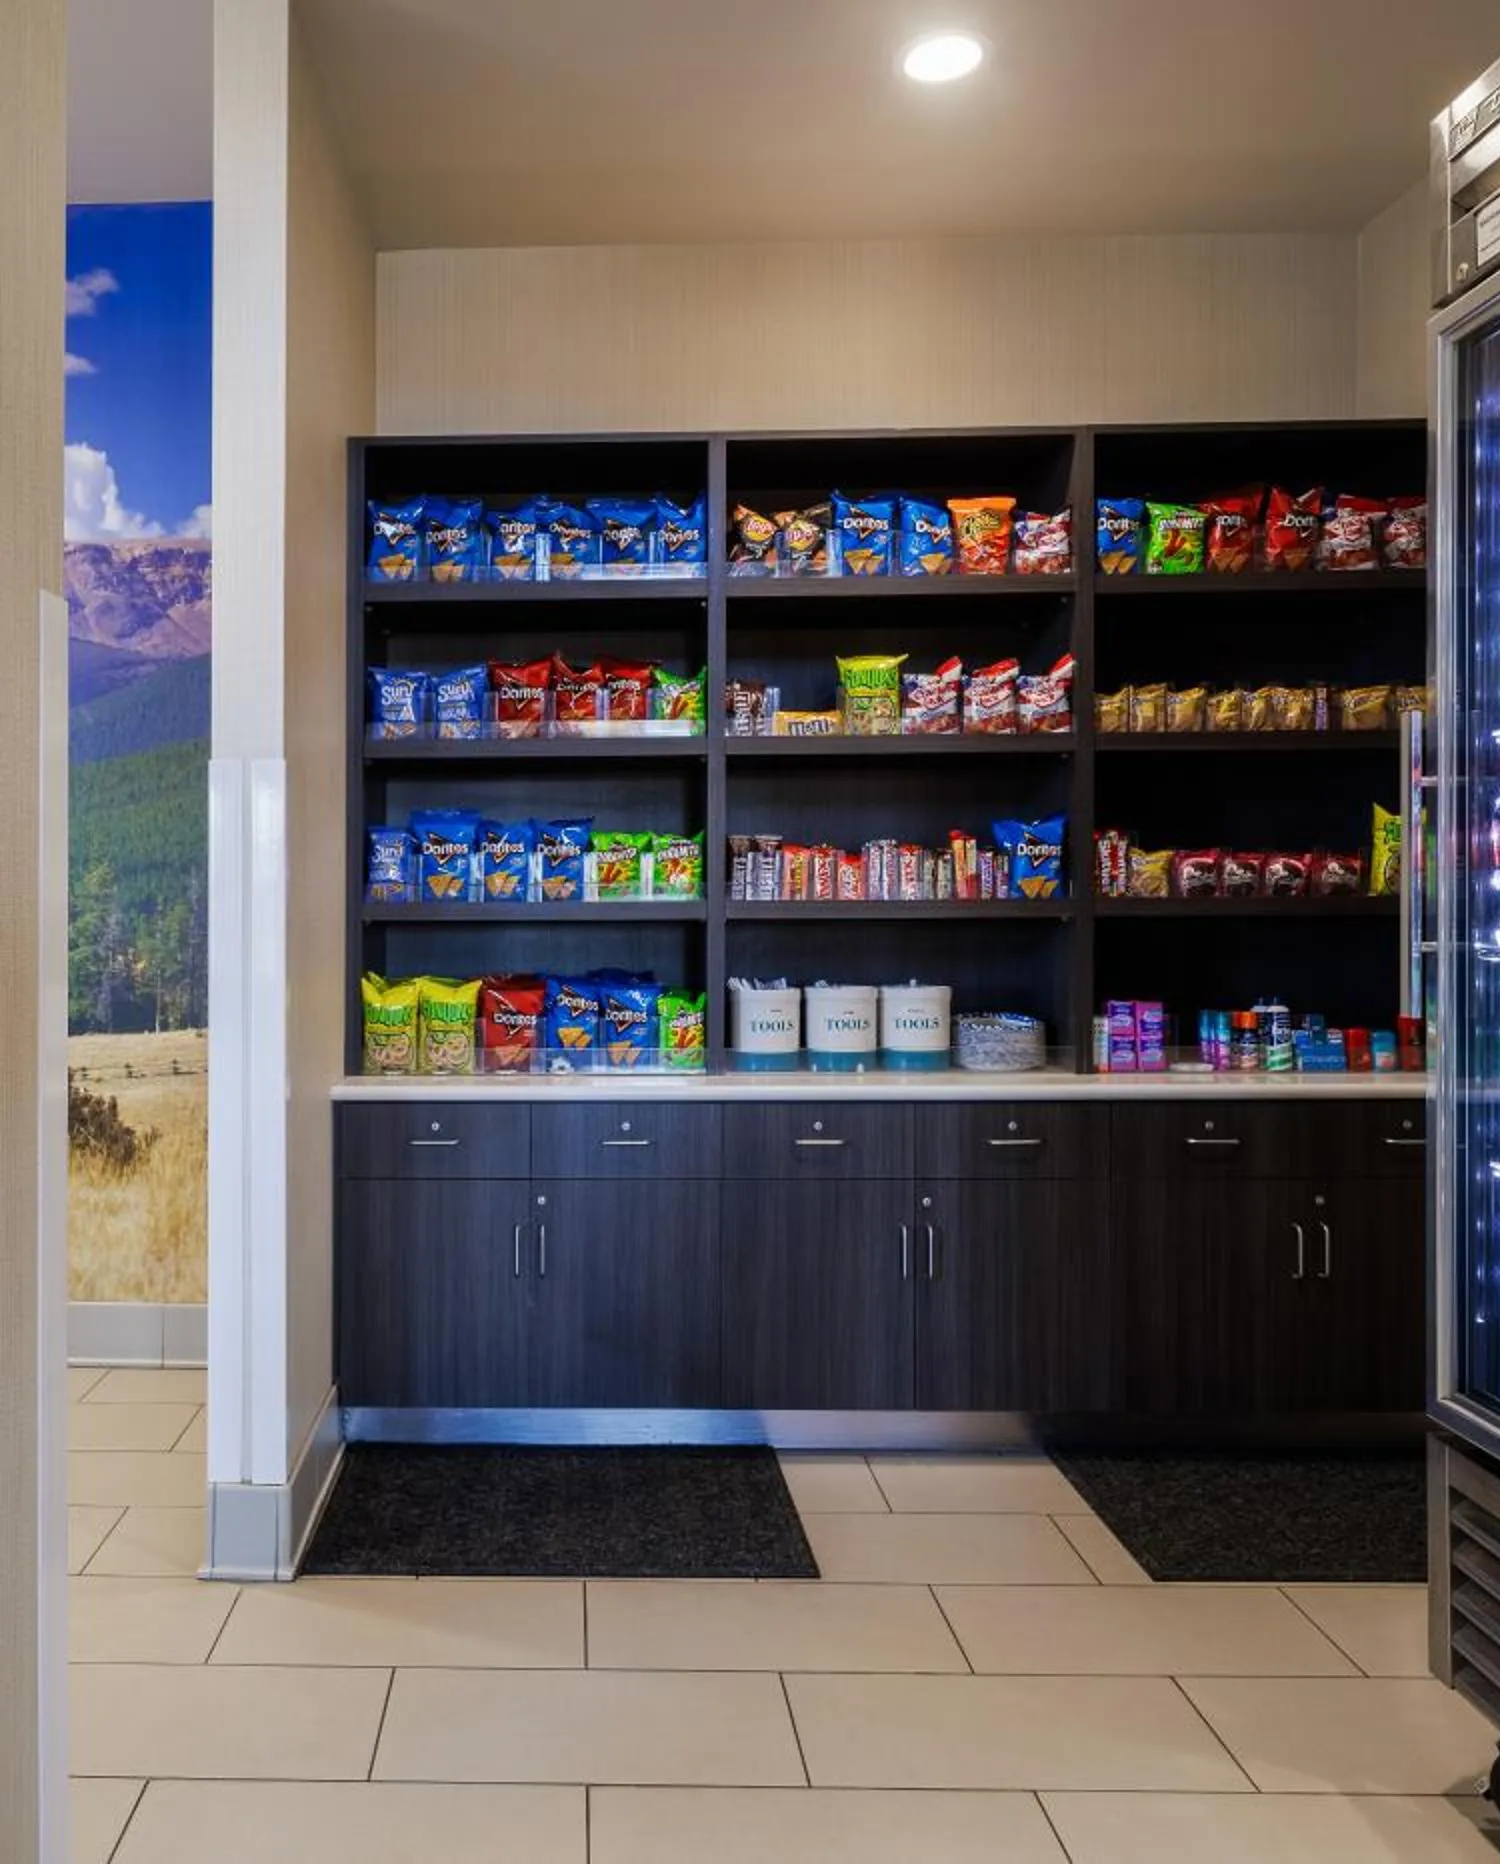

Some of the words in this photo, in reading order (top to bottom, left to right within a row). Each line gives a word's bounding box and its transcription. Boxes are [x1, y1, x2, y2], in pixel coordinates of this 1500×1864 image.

[422, 841, 469, 855] Doritos
[751, 1020, 796, 1033] TOOLS
[826, 1018, 870, 1032] TOOLS
[894, 1017, 941, 1030] TOOLS
